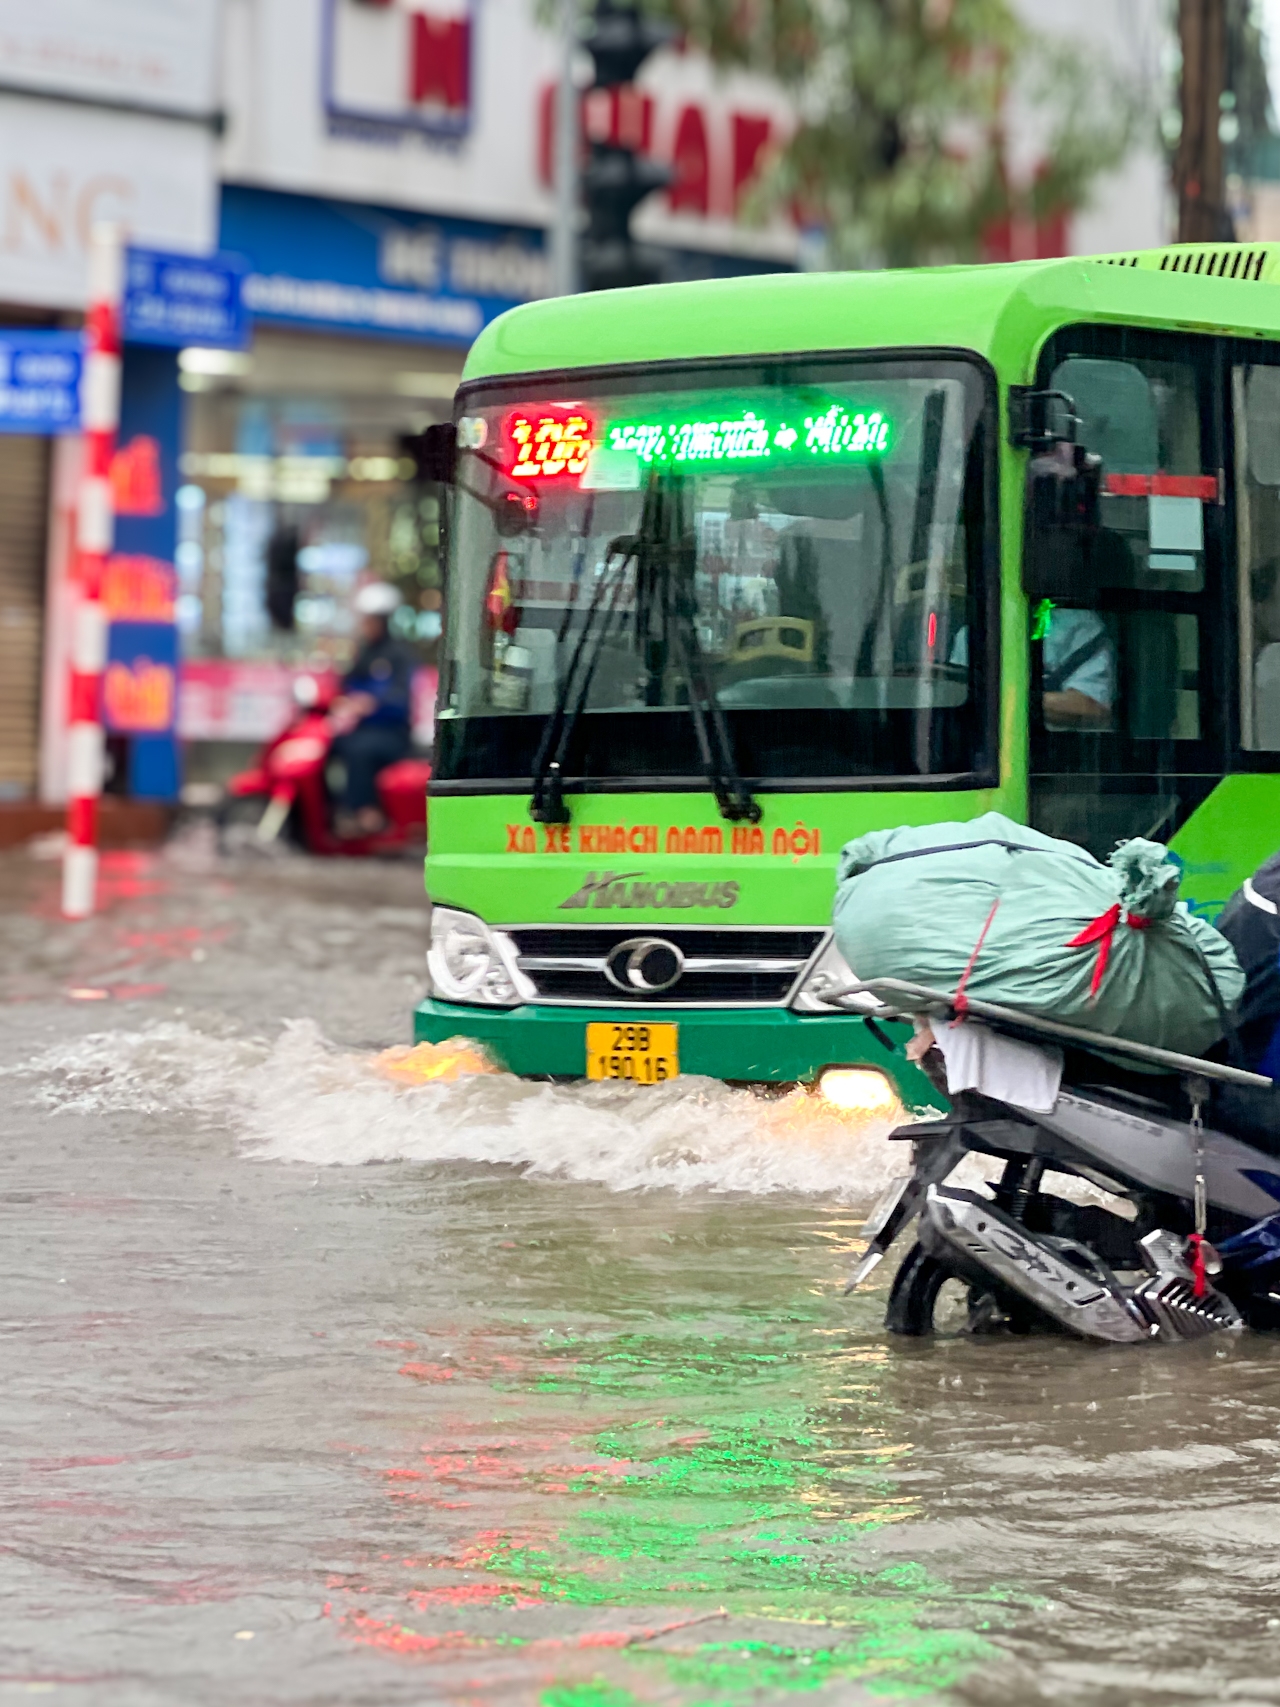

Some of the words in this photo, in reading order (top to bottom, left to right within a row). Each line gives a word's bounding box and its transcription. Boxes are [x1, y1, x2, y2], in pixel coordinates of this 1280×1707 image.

[543, 823, 571, 853] XE
[578, 818, 659, 854] KHÁCH
[665, 825, 724, 855] NAM
[771, 821, 822, 864] NỘI
[612, 1026, 651, 1051] 29B
